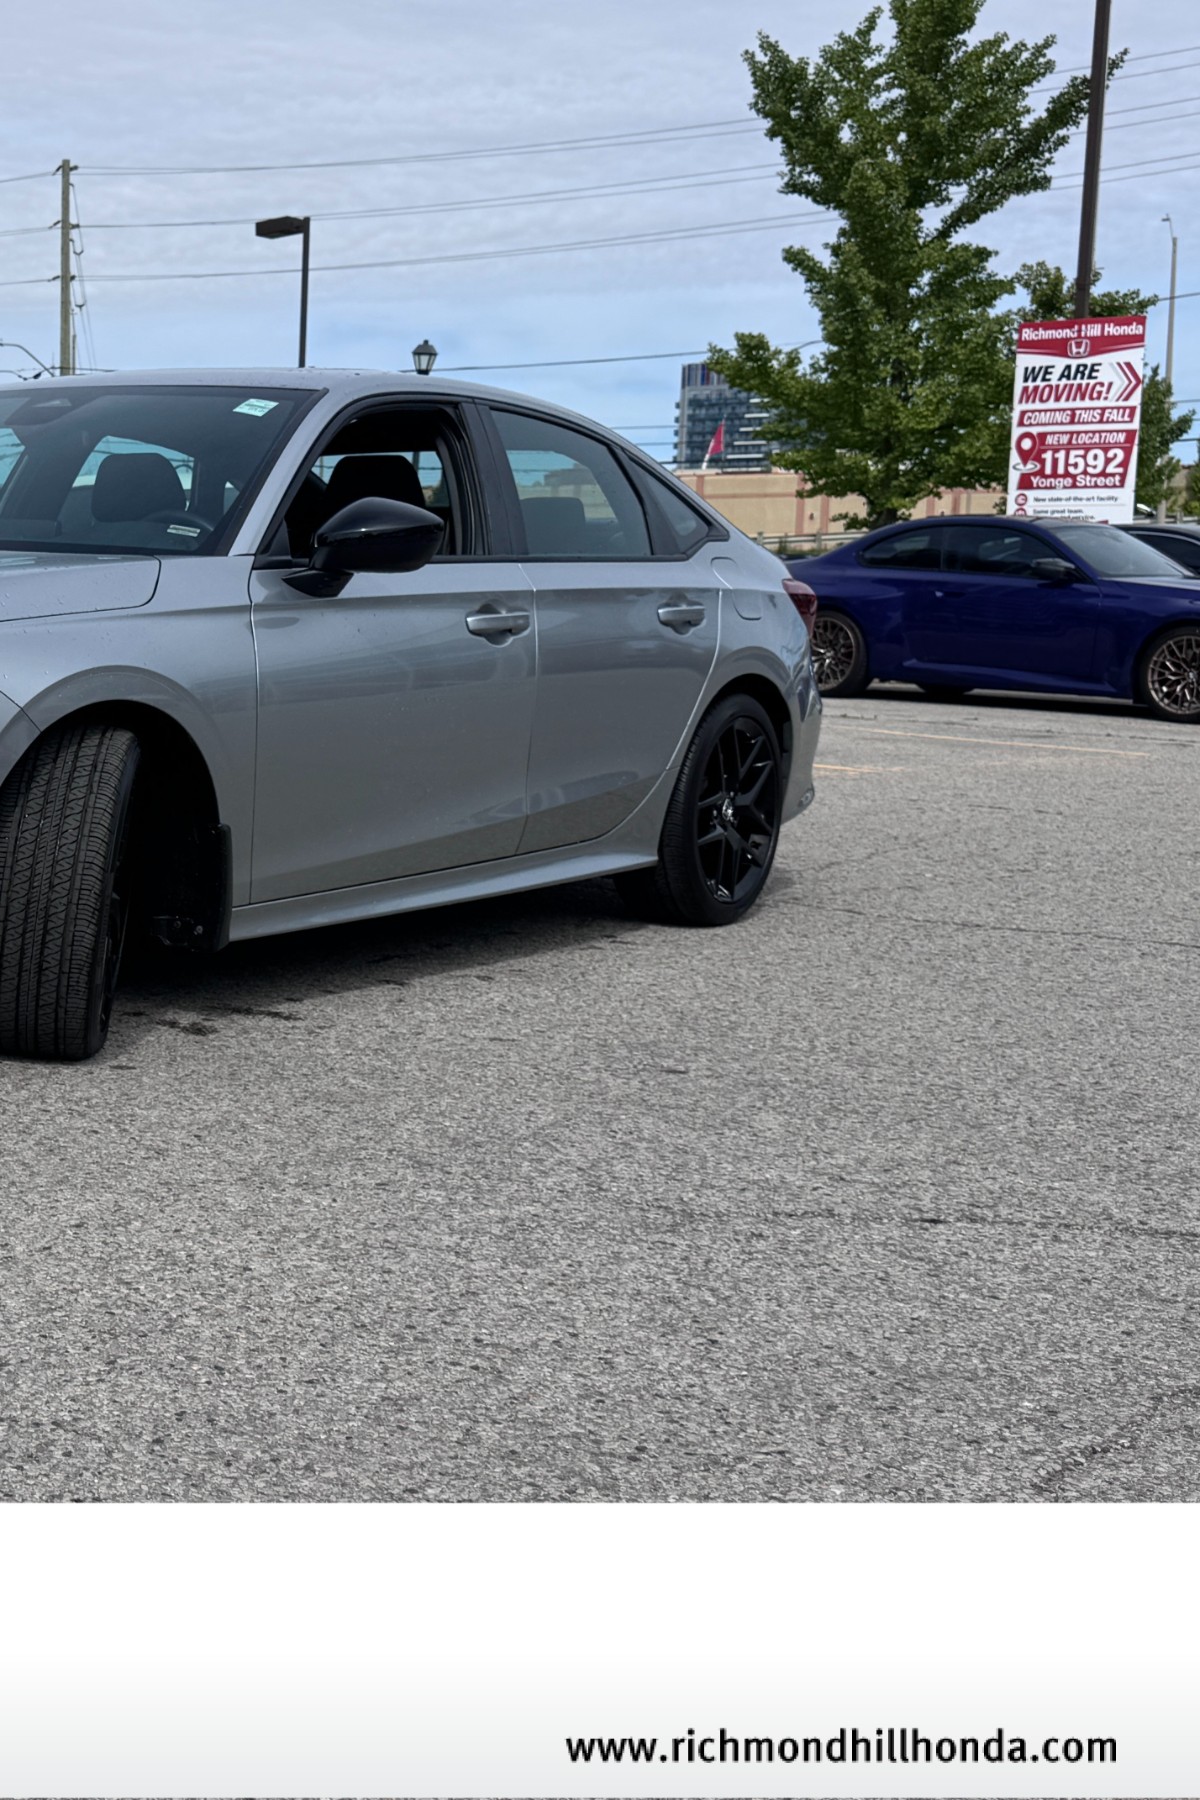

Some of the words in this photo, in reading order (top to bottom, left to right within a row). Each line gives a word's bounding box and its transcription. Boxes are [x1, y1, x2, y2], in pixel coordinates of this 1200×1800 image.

[1022, 324, 1078, 341] Richmond
[1081, 323, 1101, 338] Hill
[1104, 322, 1143, 336] Honda
[1022, 365, 1055, 383] WE
[1058, 363, 1102, 381] ARE
[1018, 381, 1113, 404] MOVING!
[1023, 411, 1071, 425] COMING
[1074, 409, 1101, 423] THIS
[1103, 408, 1131, 421] FALL
[1045, 433, 1070, 445] NEW
[1072, 432, 1126, 444] LOCATION
[1041, 448, 1125, 475] 11592
[1031, 475, 1073, 489] Yonge
[1076, 474, 1121, 486] Street
